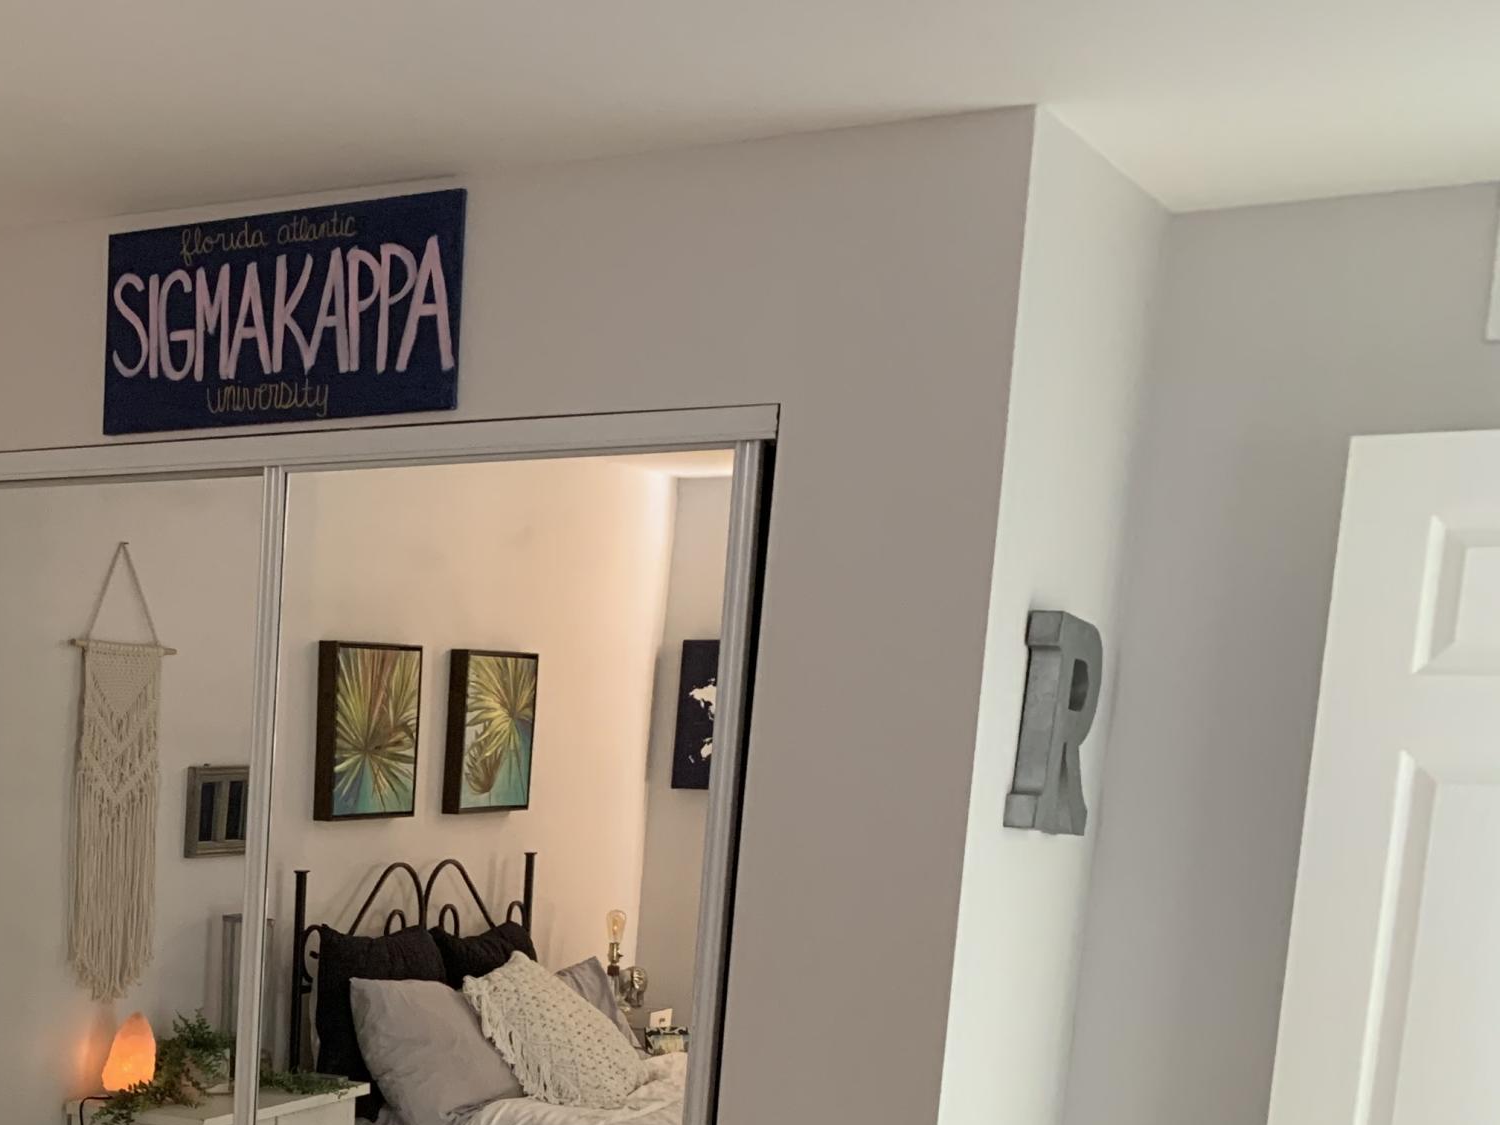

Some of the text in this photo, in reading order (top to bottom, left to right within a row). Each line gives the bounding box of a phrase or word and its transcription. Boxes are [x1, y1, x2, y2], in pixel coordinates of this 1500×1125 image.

[181, 211, 358, 266] florida atlantic
[207, 378, 328, 416] university
